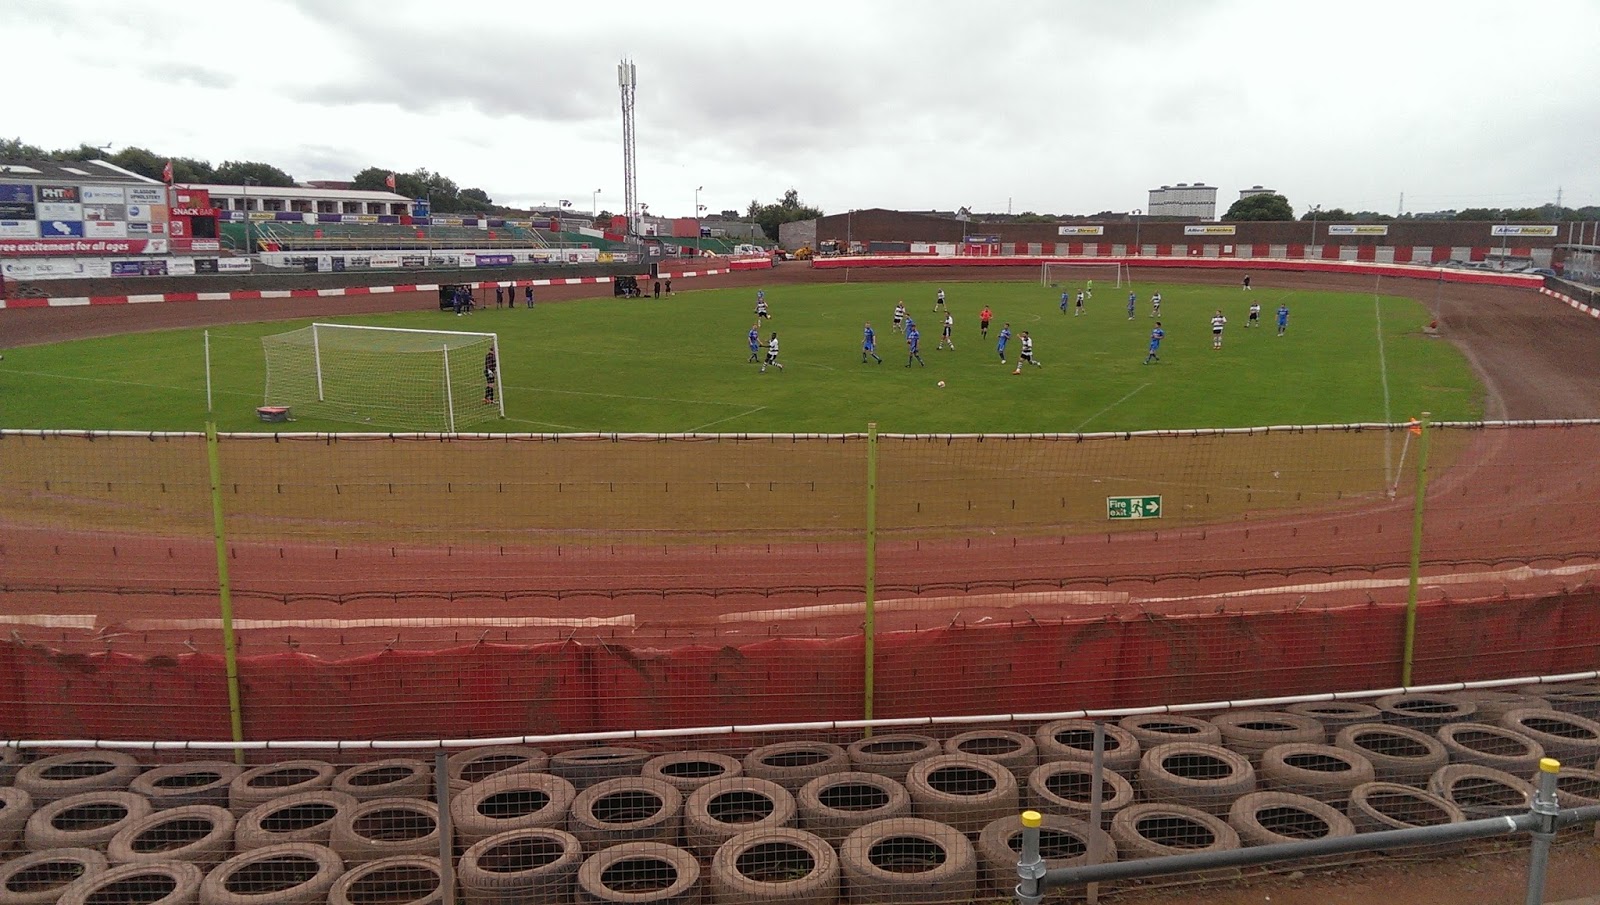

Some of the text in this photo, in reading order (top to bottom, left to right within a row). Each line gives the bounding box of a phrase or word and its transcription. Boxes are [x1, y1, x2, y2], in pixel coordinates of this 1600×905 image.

[42, 188, 75, 198] PHTM
[172, 208, 214, 216] SNACK BAR
[17, 241, 75, 252] excitement
[76, 241, 91, 251] for
[92, 241, 106, 251] all
[106, 243, 129, 253] ages
[1109, 500, 1127, 508] Fire
[1109, 508, 1127, 517] exit
